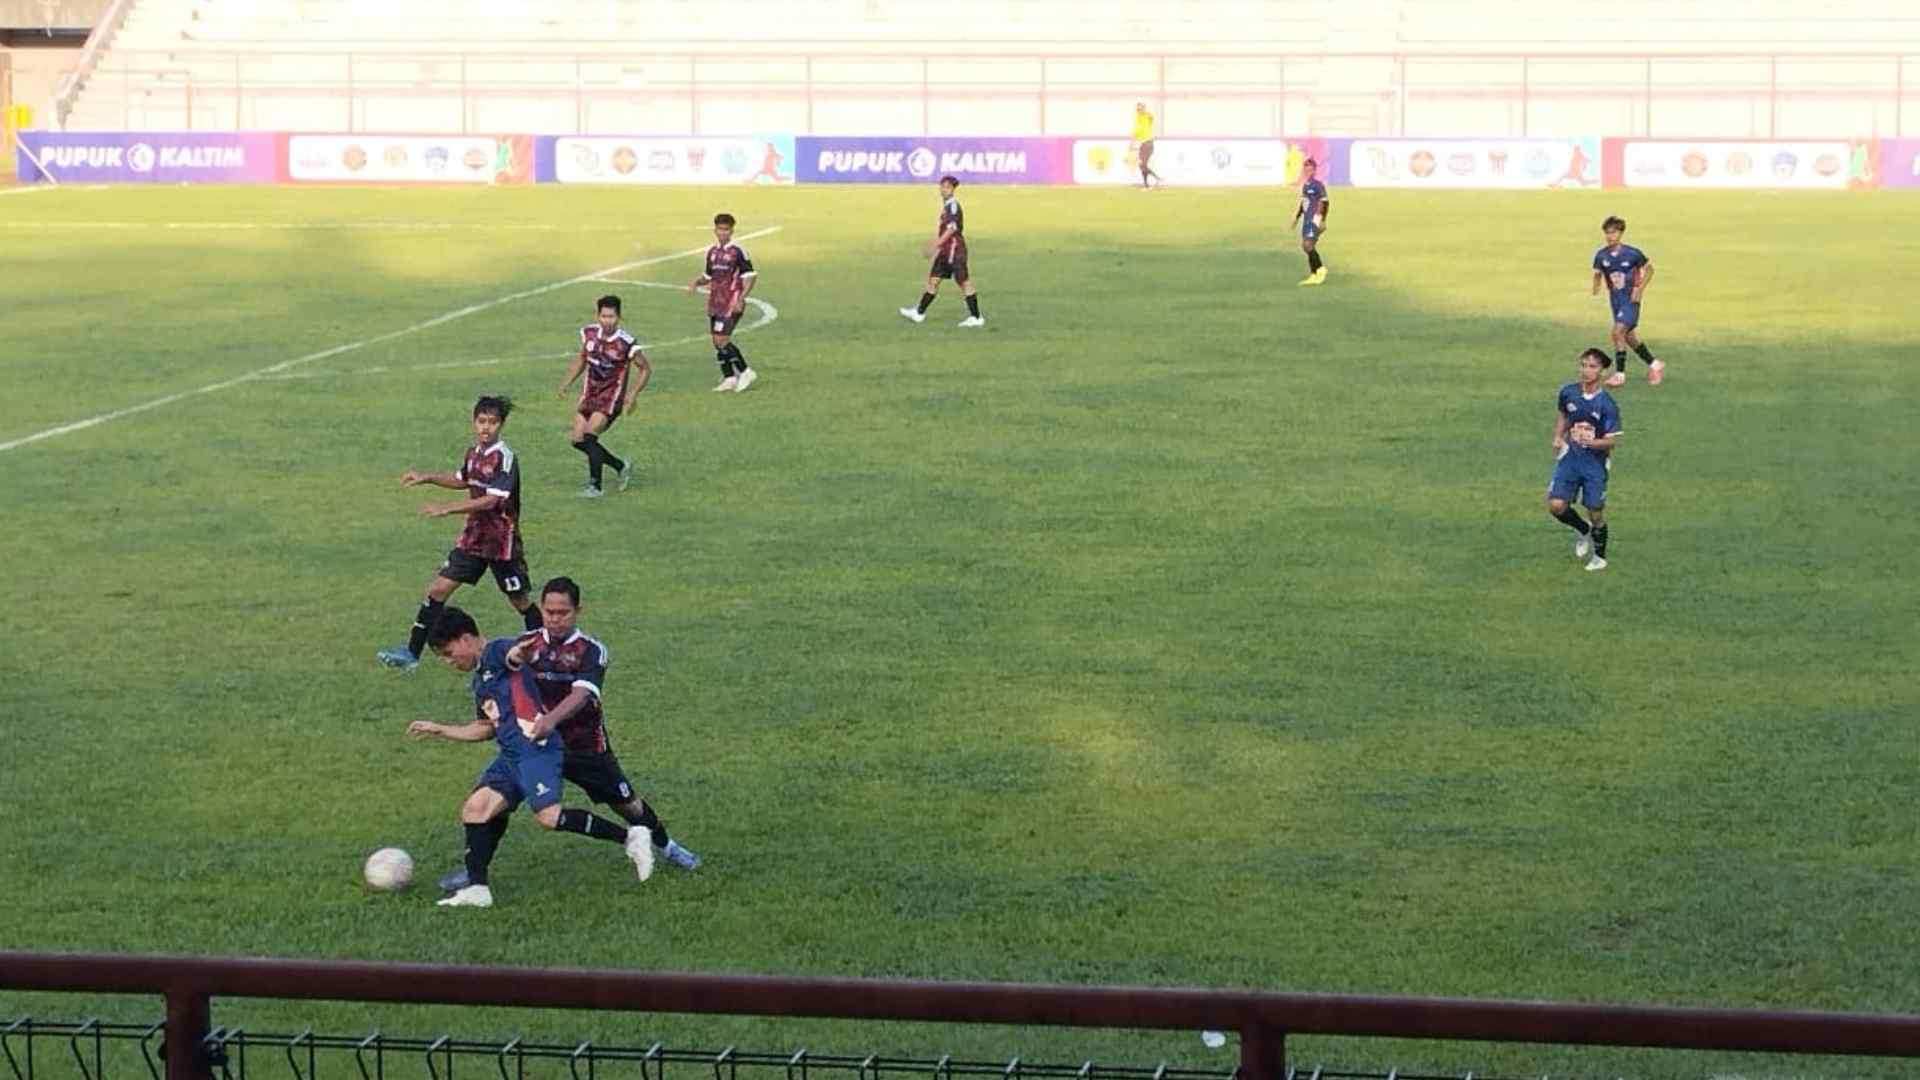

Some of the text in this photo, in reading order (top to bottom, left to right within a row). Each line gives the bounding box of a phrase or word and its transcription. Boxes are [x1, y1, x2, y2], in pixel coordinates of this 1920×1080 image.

[40, 146, 244, 167] PUPUK KALTIM
[818, 150, 1026, 173] PUPUK KALTIM
